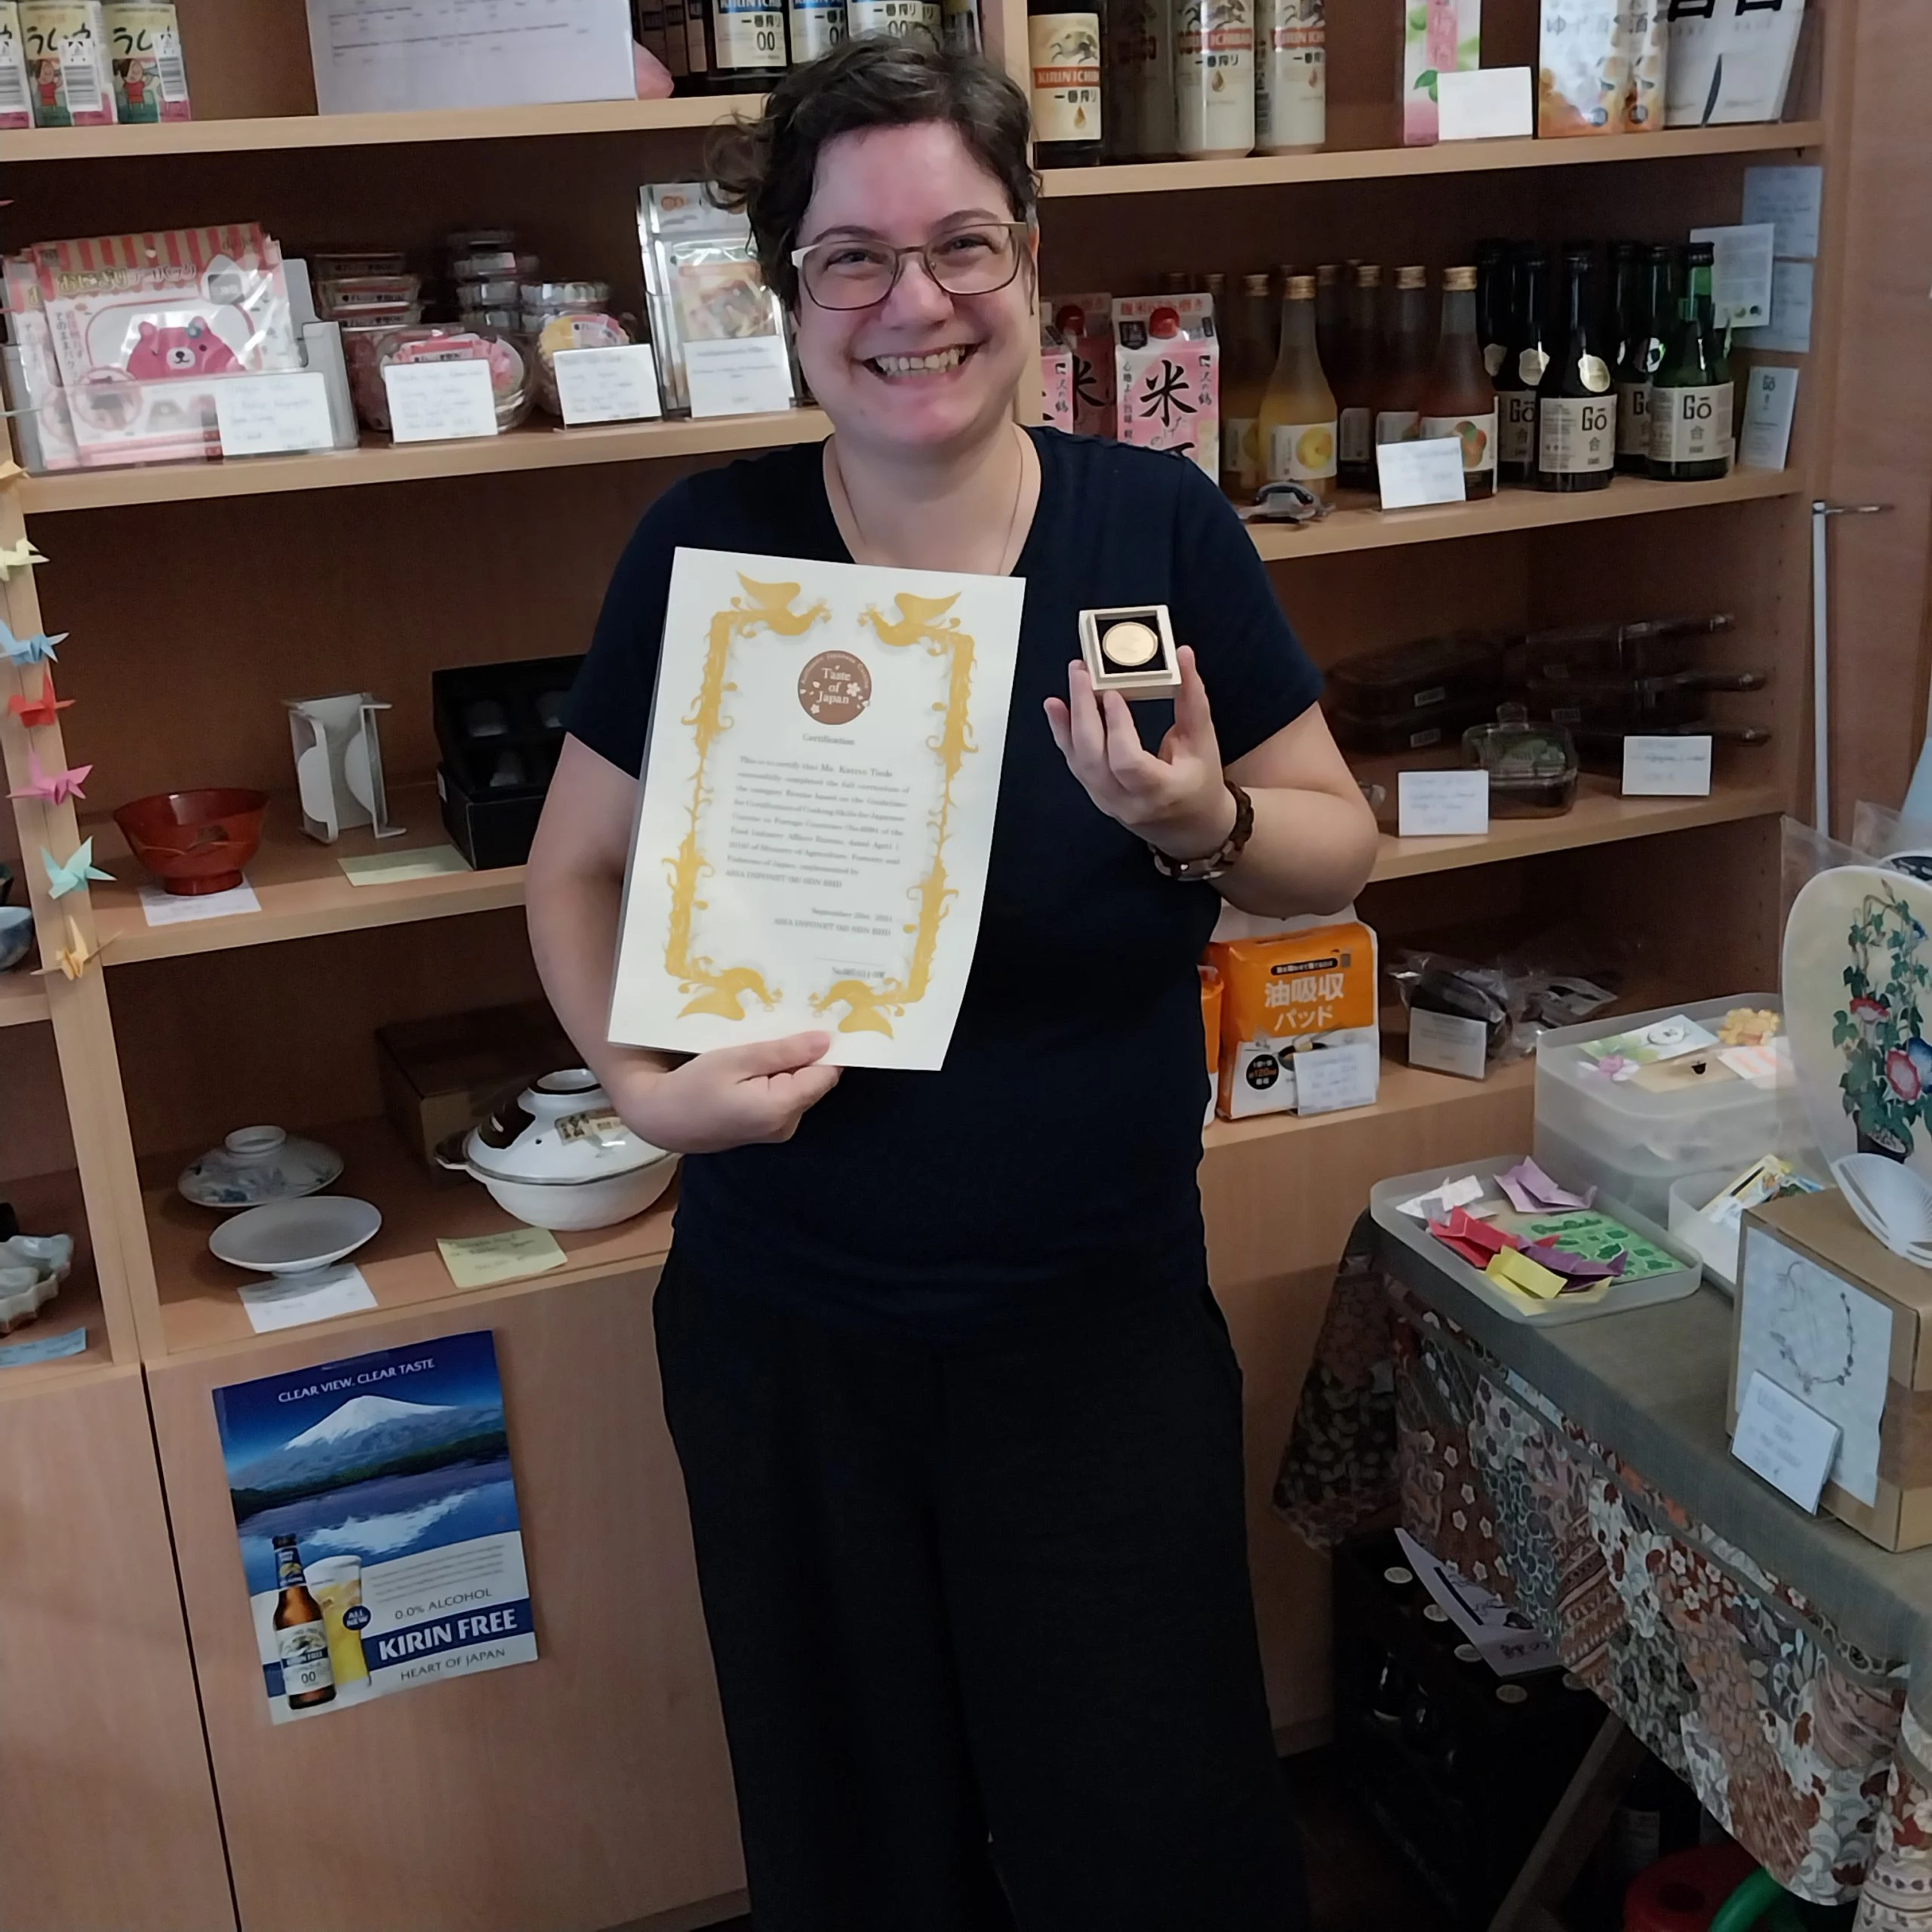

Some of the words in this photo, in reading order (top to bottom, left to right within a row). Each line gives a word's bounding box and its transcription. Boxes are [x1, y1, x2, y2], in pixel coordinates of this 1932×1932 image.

[1038, 69, 1070, 84] KIRIN
[1140, 359, 1198, 428] 米
[1582, 406, 1607, 431] Gō
[1683, 395, 1712, 420] Gō
[822, 668, 851, 681] Taste
[816, 691, 849, 705] Japan
[828, 682, 842, 693] of
[802, 734, 855, 746] Certification
[1264, 973, 1346, 1008] 油吸収
[1273, 1004, 1334, 1032] パッド
[278, 1386, 319, 1402] CLEAR
[321, 1377, 355, 1392] VIEW.
[357, 1367, 397, 1384] CLEAR
[398, 1358, 435, 1374] TASTE
[348, 1609, 364, 1619] ALL
[395, 1605, 425, 1620] 0.0%
[429, 1587, 493, 1611] ALCOHOL
[346, 1615, 368, 1626] NEW
[379, 1623, 452, 1660] KIRIN
[457, 1608, 517, 1640] FREE
[401, 1661, 441, 1681] HEART
[445, 1657, 461, 1668] OF
[466, 1648, 505, 1666] JAPAN
